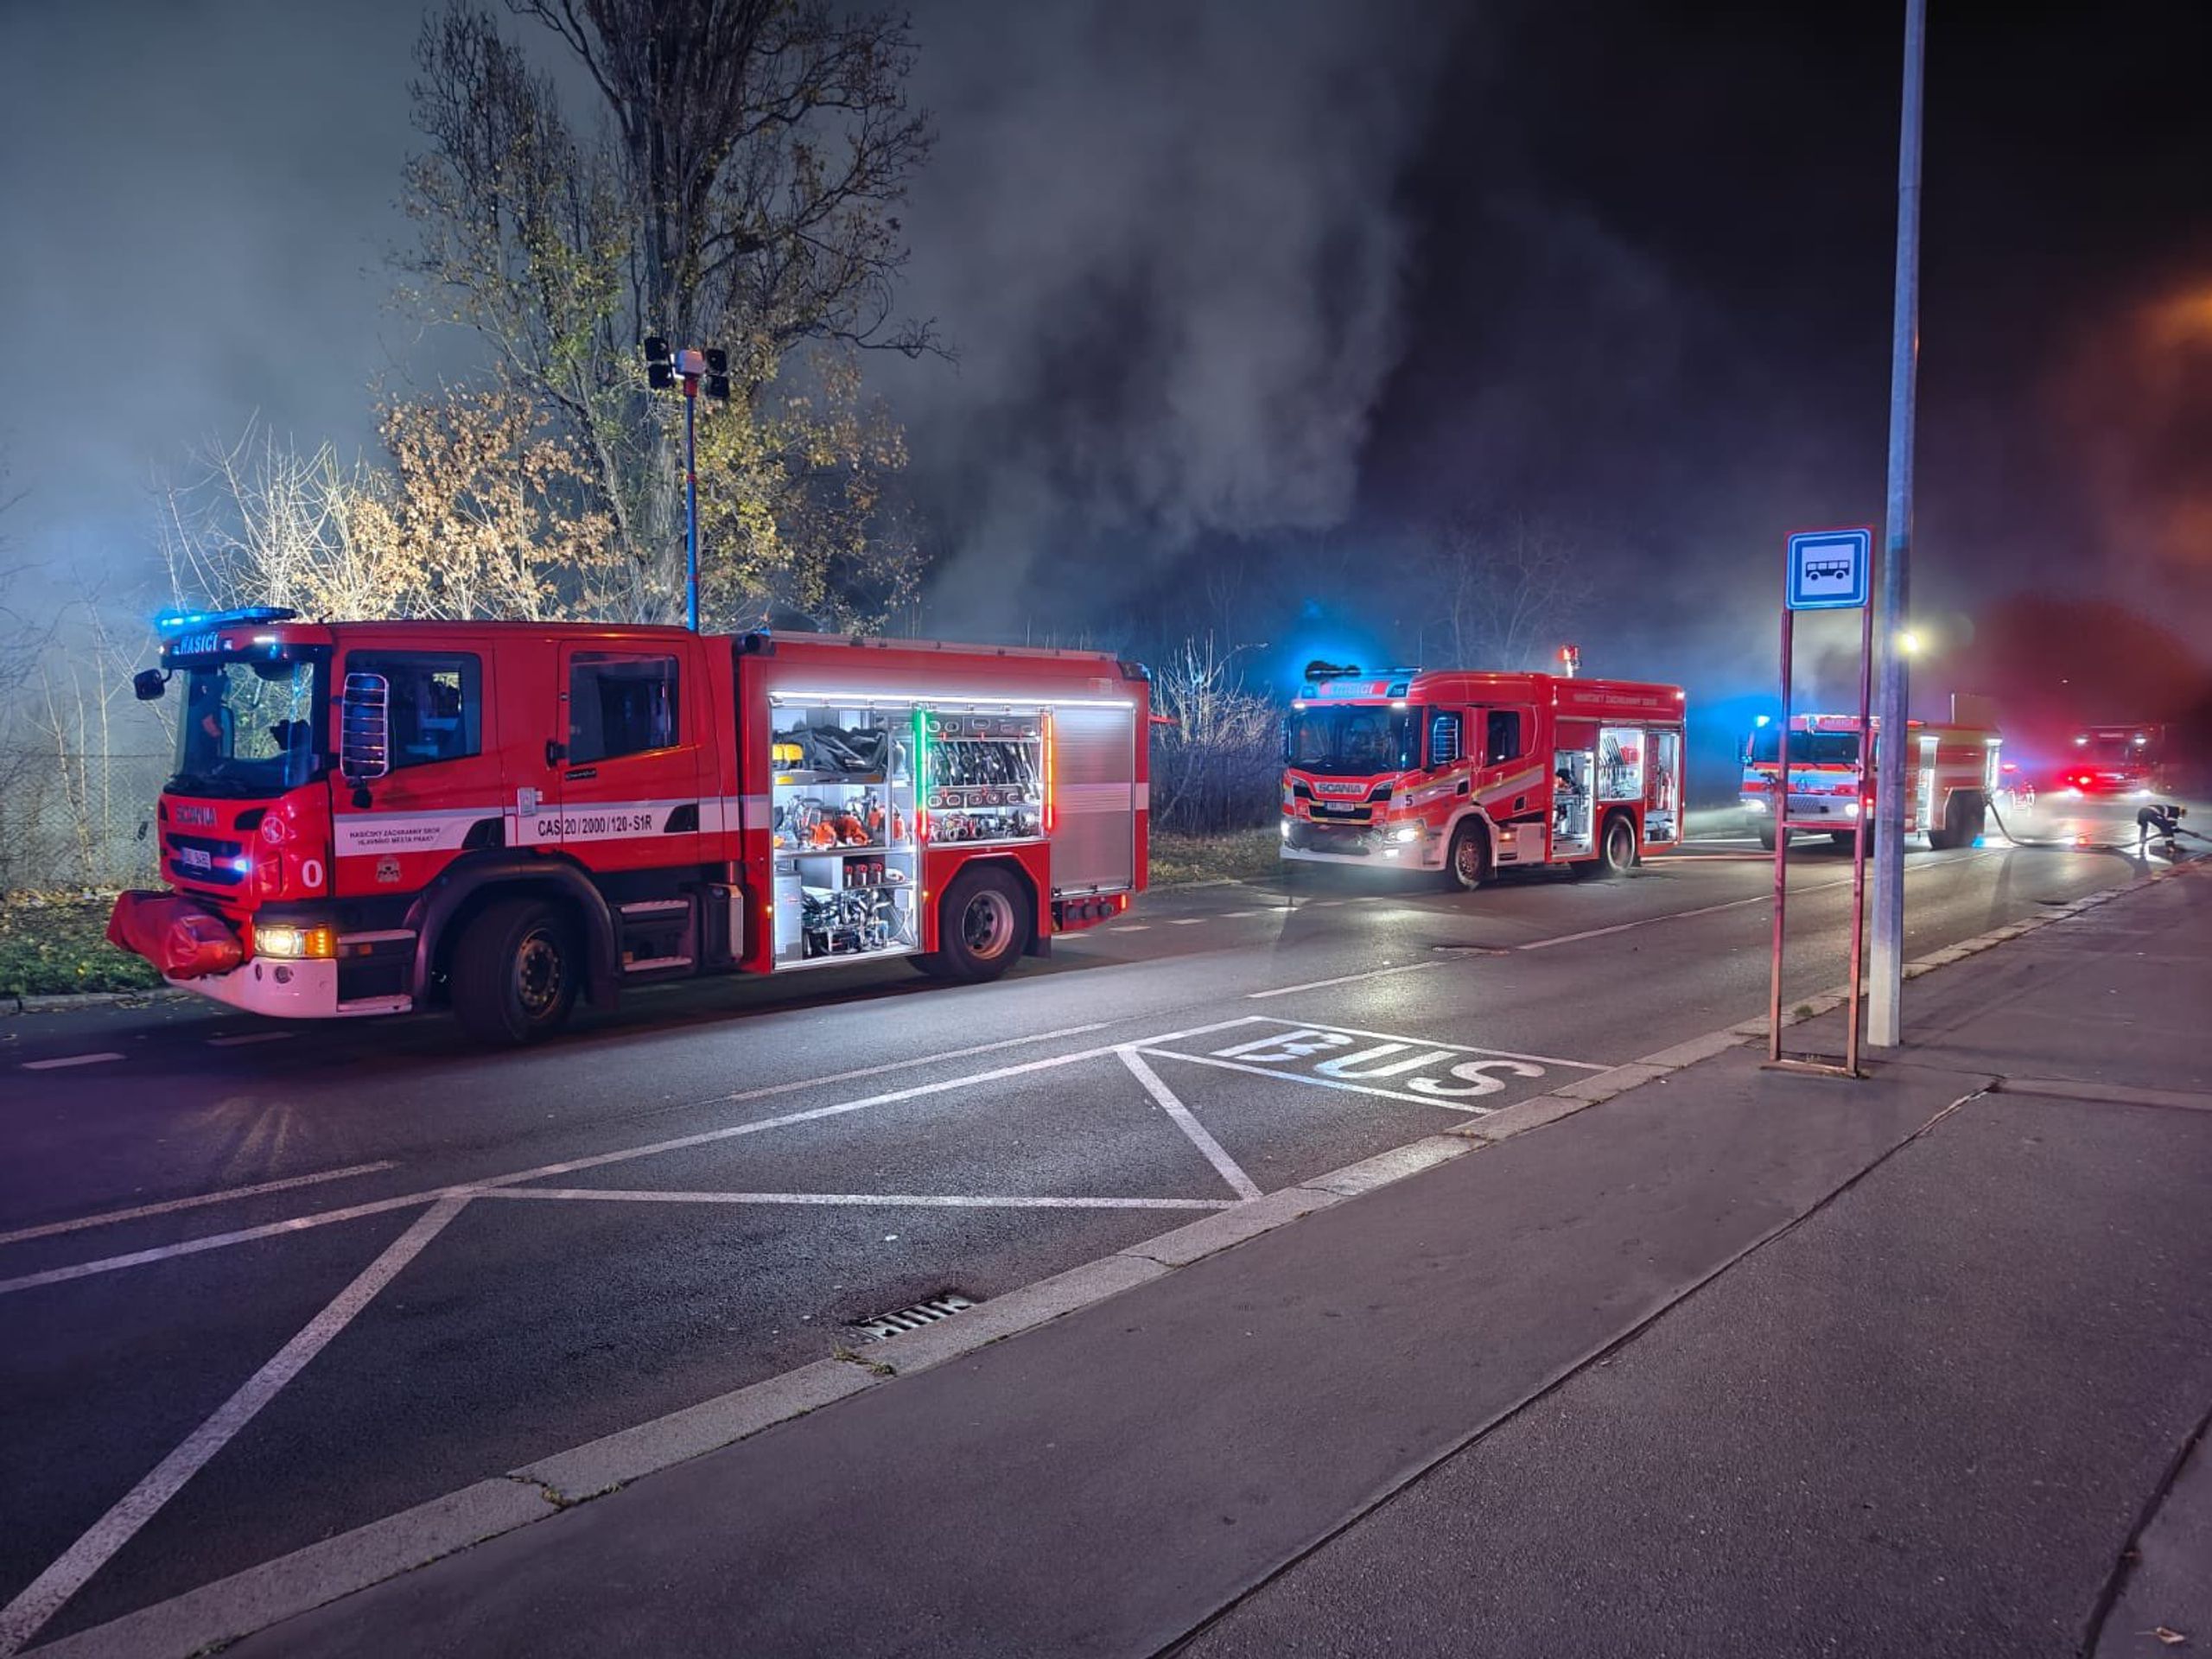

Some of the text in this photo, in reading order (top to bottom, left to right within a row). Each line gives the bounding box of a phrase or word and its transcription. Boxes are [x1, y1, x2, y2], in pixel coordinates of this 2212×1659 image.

[1318, 783, 1363, 793] SCANIA
[1405, 795, 1414, 807] 5
[537, 819, 561, 836] CAS
[302, 859, 323, 887] 0
[1210, 1029, 1546, 1096] BUS
